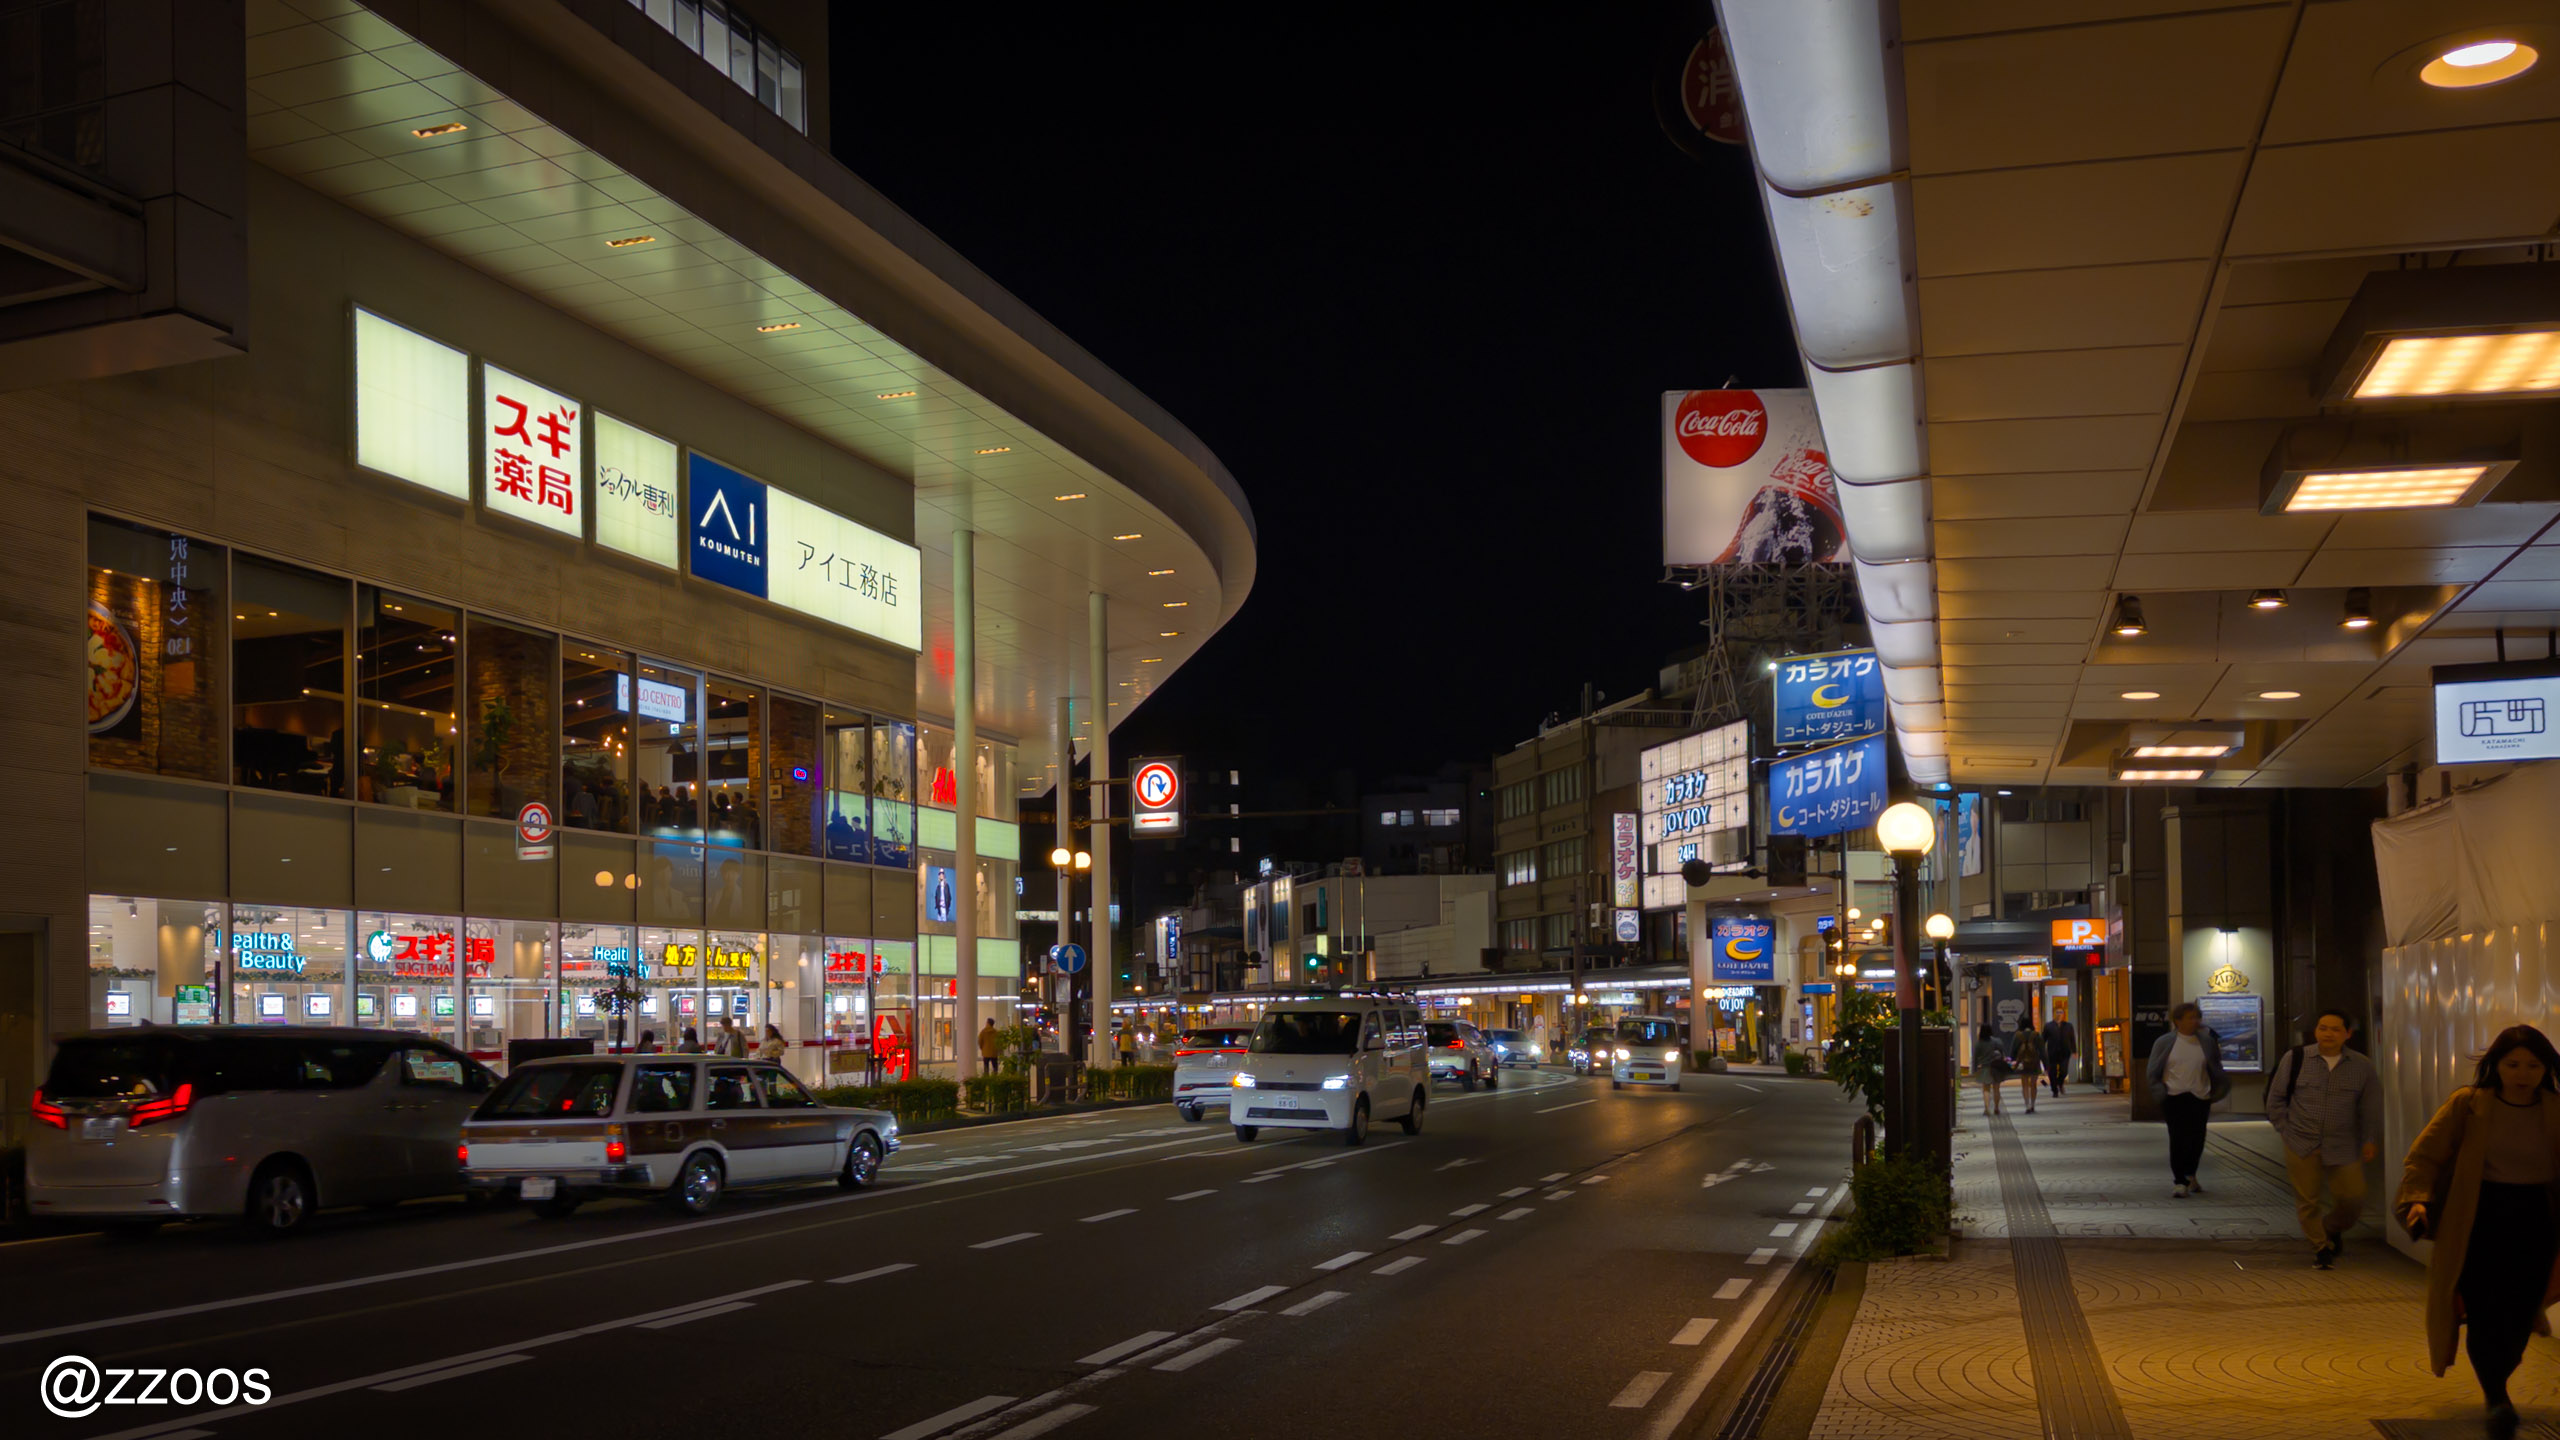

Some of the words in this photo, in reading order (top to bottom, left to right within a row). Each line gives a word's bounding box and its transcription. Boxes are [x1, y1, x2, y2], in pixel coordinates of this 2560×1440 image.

[494, 394, 576, 459] スギ
[1679, 409, 1763, 437] Coca-Cola
[494, 448, 573, 515] 薬局
[700, 488, 755, 545] AI
[700, 536, 760, 567] KOUMUTEN
[797, 540, 898, 607] アイ工務店
[1786, 656, 1876, 684] カラオケ
[1785, 719, 1876, 737] コート・ダジュール
[1665, 770, 1706, 804] カラオケ
[1786, 749, 1864, 799] カラオケ
[1799, 791, 1881, 826] コート・ダジュール
[1616, 815, 1636, 880] カラオケ
[1678, 844, 1697, 863] 24H
[1717, 925, 1769, 937] カラオケ
[240, 951, 306, 974] Beauty
